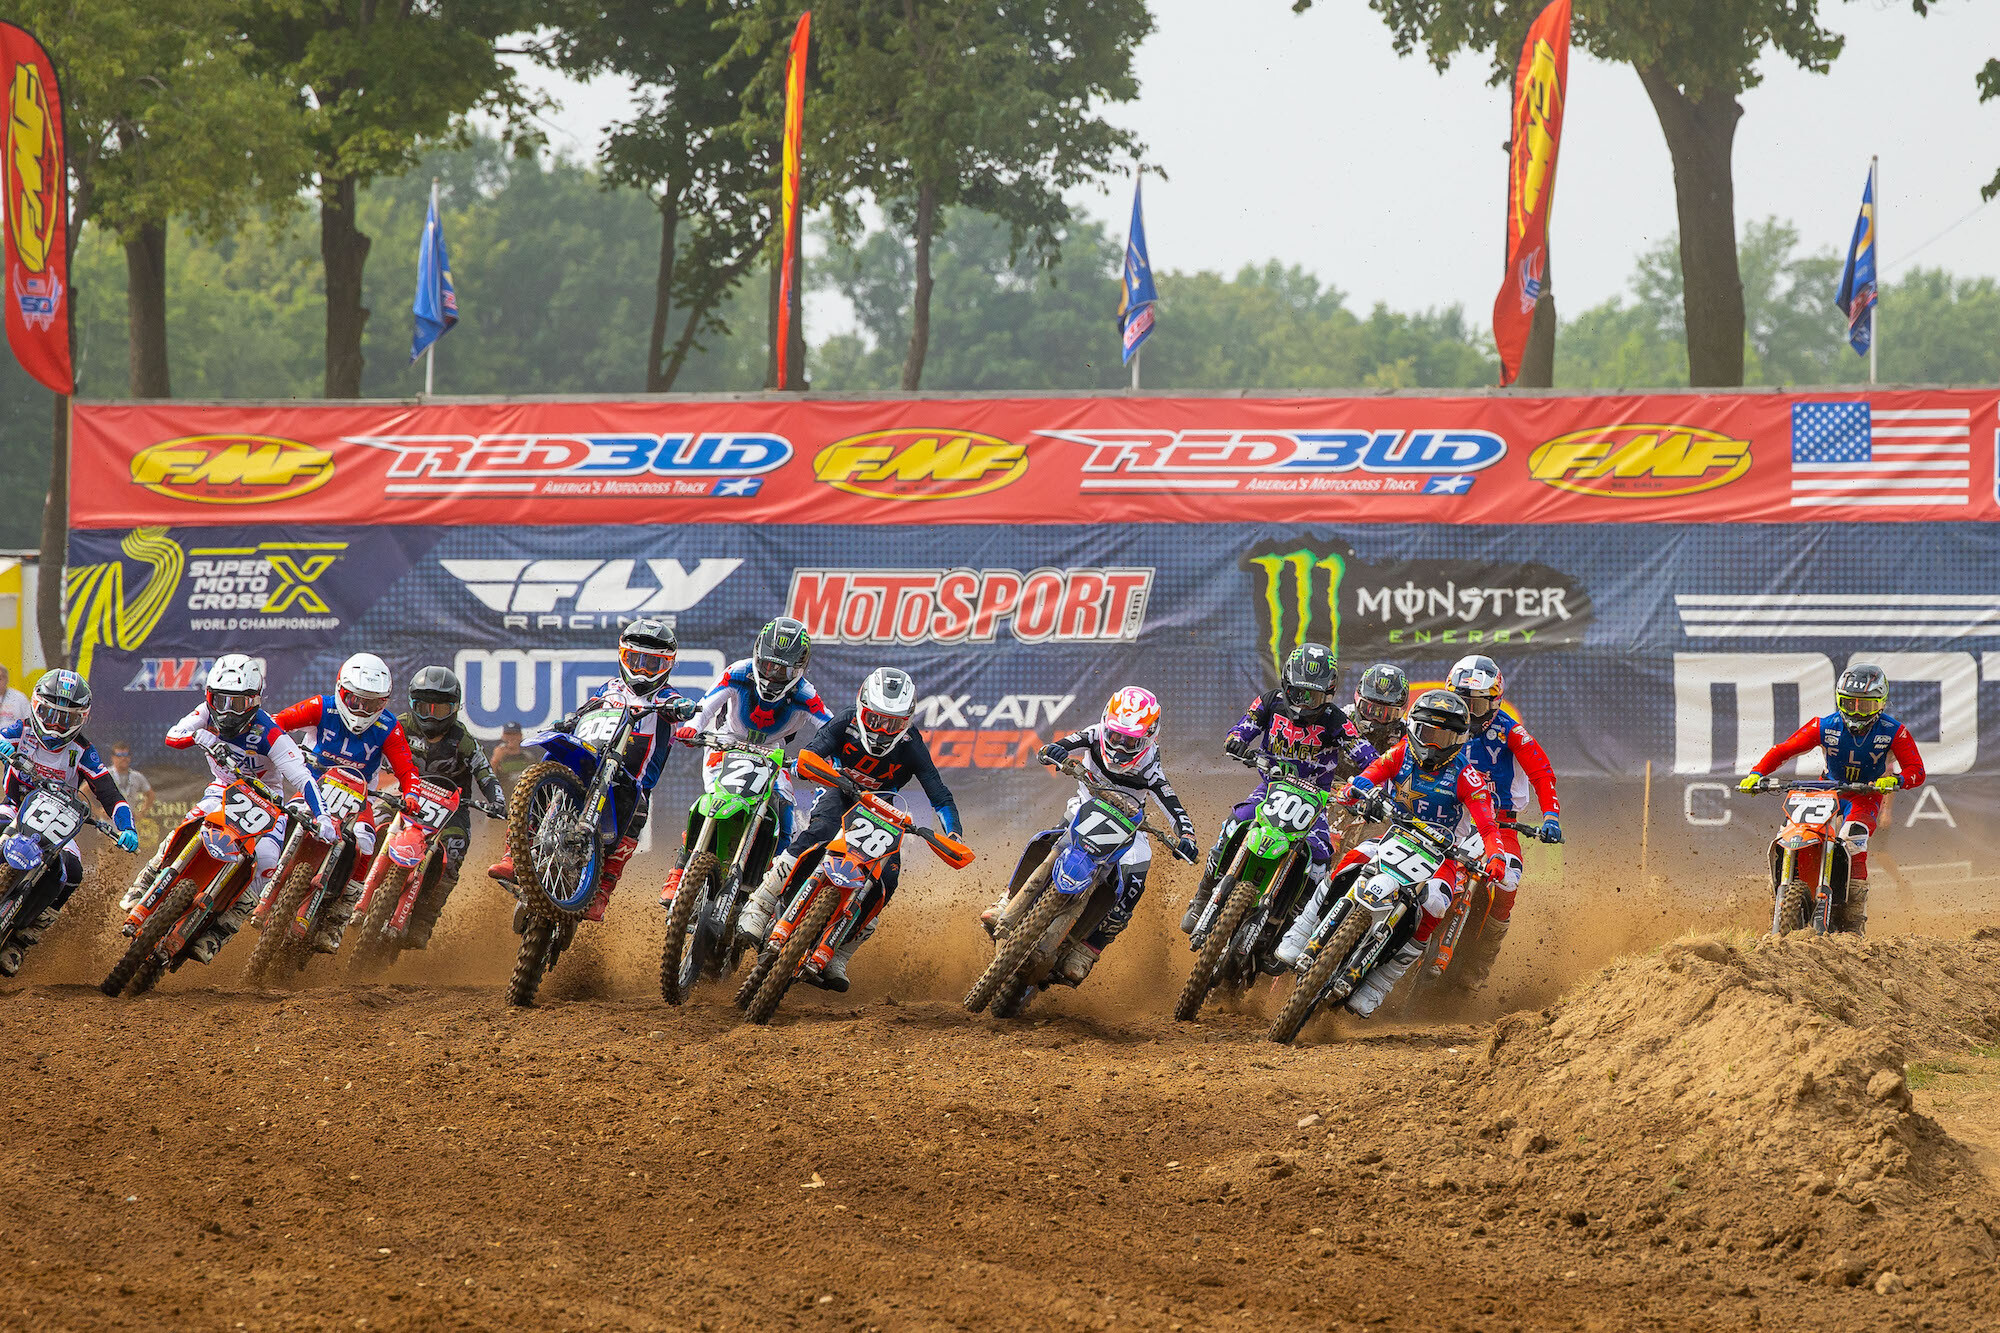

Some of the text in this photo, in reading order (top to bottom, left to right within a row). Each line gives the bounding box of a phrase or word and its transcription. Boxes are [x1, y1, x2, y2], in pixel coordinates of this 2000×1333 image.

[13, 60, 45, 273] FMF
[130, 443, 334, 486] FMF
[338, 433, 794, 478] REDBUD
[814, 438, 1028, 482] FMF
[1030, 429, 1508, 473] REDBUD
[1530, 433, 1752, 480] FMF
[672, 480, 707, 495] TRACK
[1384, 477, 1418, 492] TRACK
[188, 559, 272, 578] SUPER
[193, 577, 268, 594] MOTO
[440, 558, 745, 613] FLY
[187, 593, 269, 611] CROSS
[1356, 581, 1572, 624] MONSTER
[190, 617, 341, 631] WORLD CHAMPIONSHIP
[503, 615, 677, 631] RACING
[1389, 629, 1537, 644] ENERGY
[1847, 680, 1866, 689] FLY
[981, 694, 1077, 728] ATV
[323, 728, 379, 761] FLY
[1269, 713, 1325, 747] FOX
[321, 750, 367, 770] GASGAS
[842, 742, 902, 779] FOX
[1466, 744, 1501, 764] LY
[1827, 747, 1884, 765] FLY
[720, 759, 770, 794] 21
[225, 793, 271, 834] 29
[247, 791, 269, 809] MARTIN
[321, 783, 361, 819] 105
[1106, 805, 1124, 821] TICKLE
[1262, 790, 1316, 831] 300
[1417, 800, 1461, 819] FLY
[1789, 799, 1836, 824] 73
[22, 799, 77, 845] 132
[845, 817, 894, 858] 28
[1074, 811, 1133, 845] 17
[6, 852, 28, 870] YAMAHA
[1379, 840, 1433, 883] 66
[145, 873, 173, 908] DUNOP
[398, 880, 420, 925] SUCK LESS
[721, 878, 740, 925] DUNLOP
[0, 895, 24, 933] DUNLOP
[1246, 909, 1269, 955] DUNLOP
